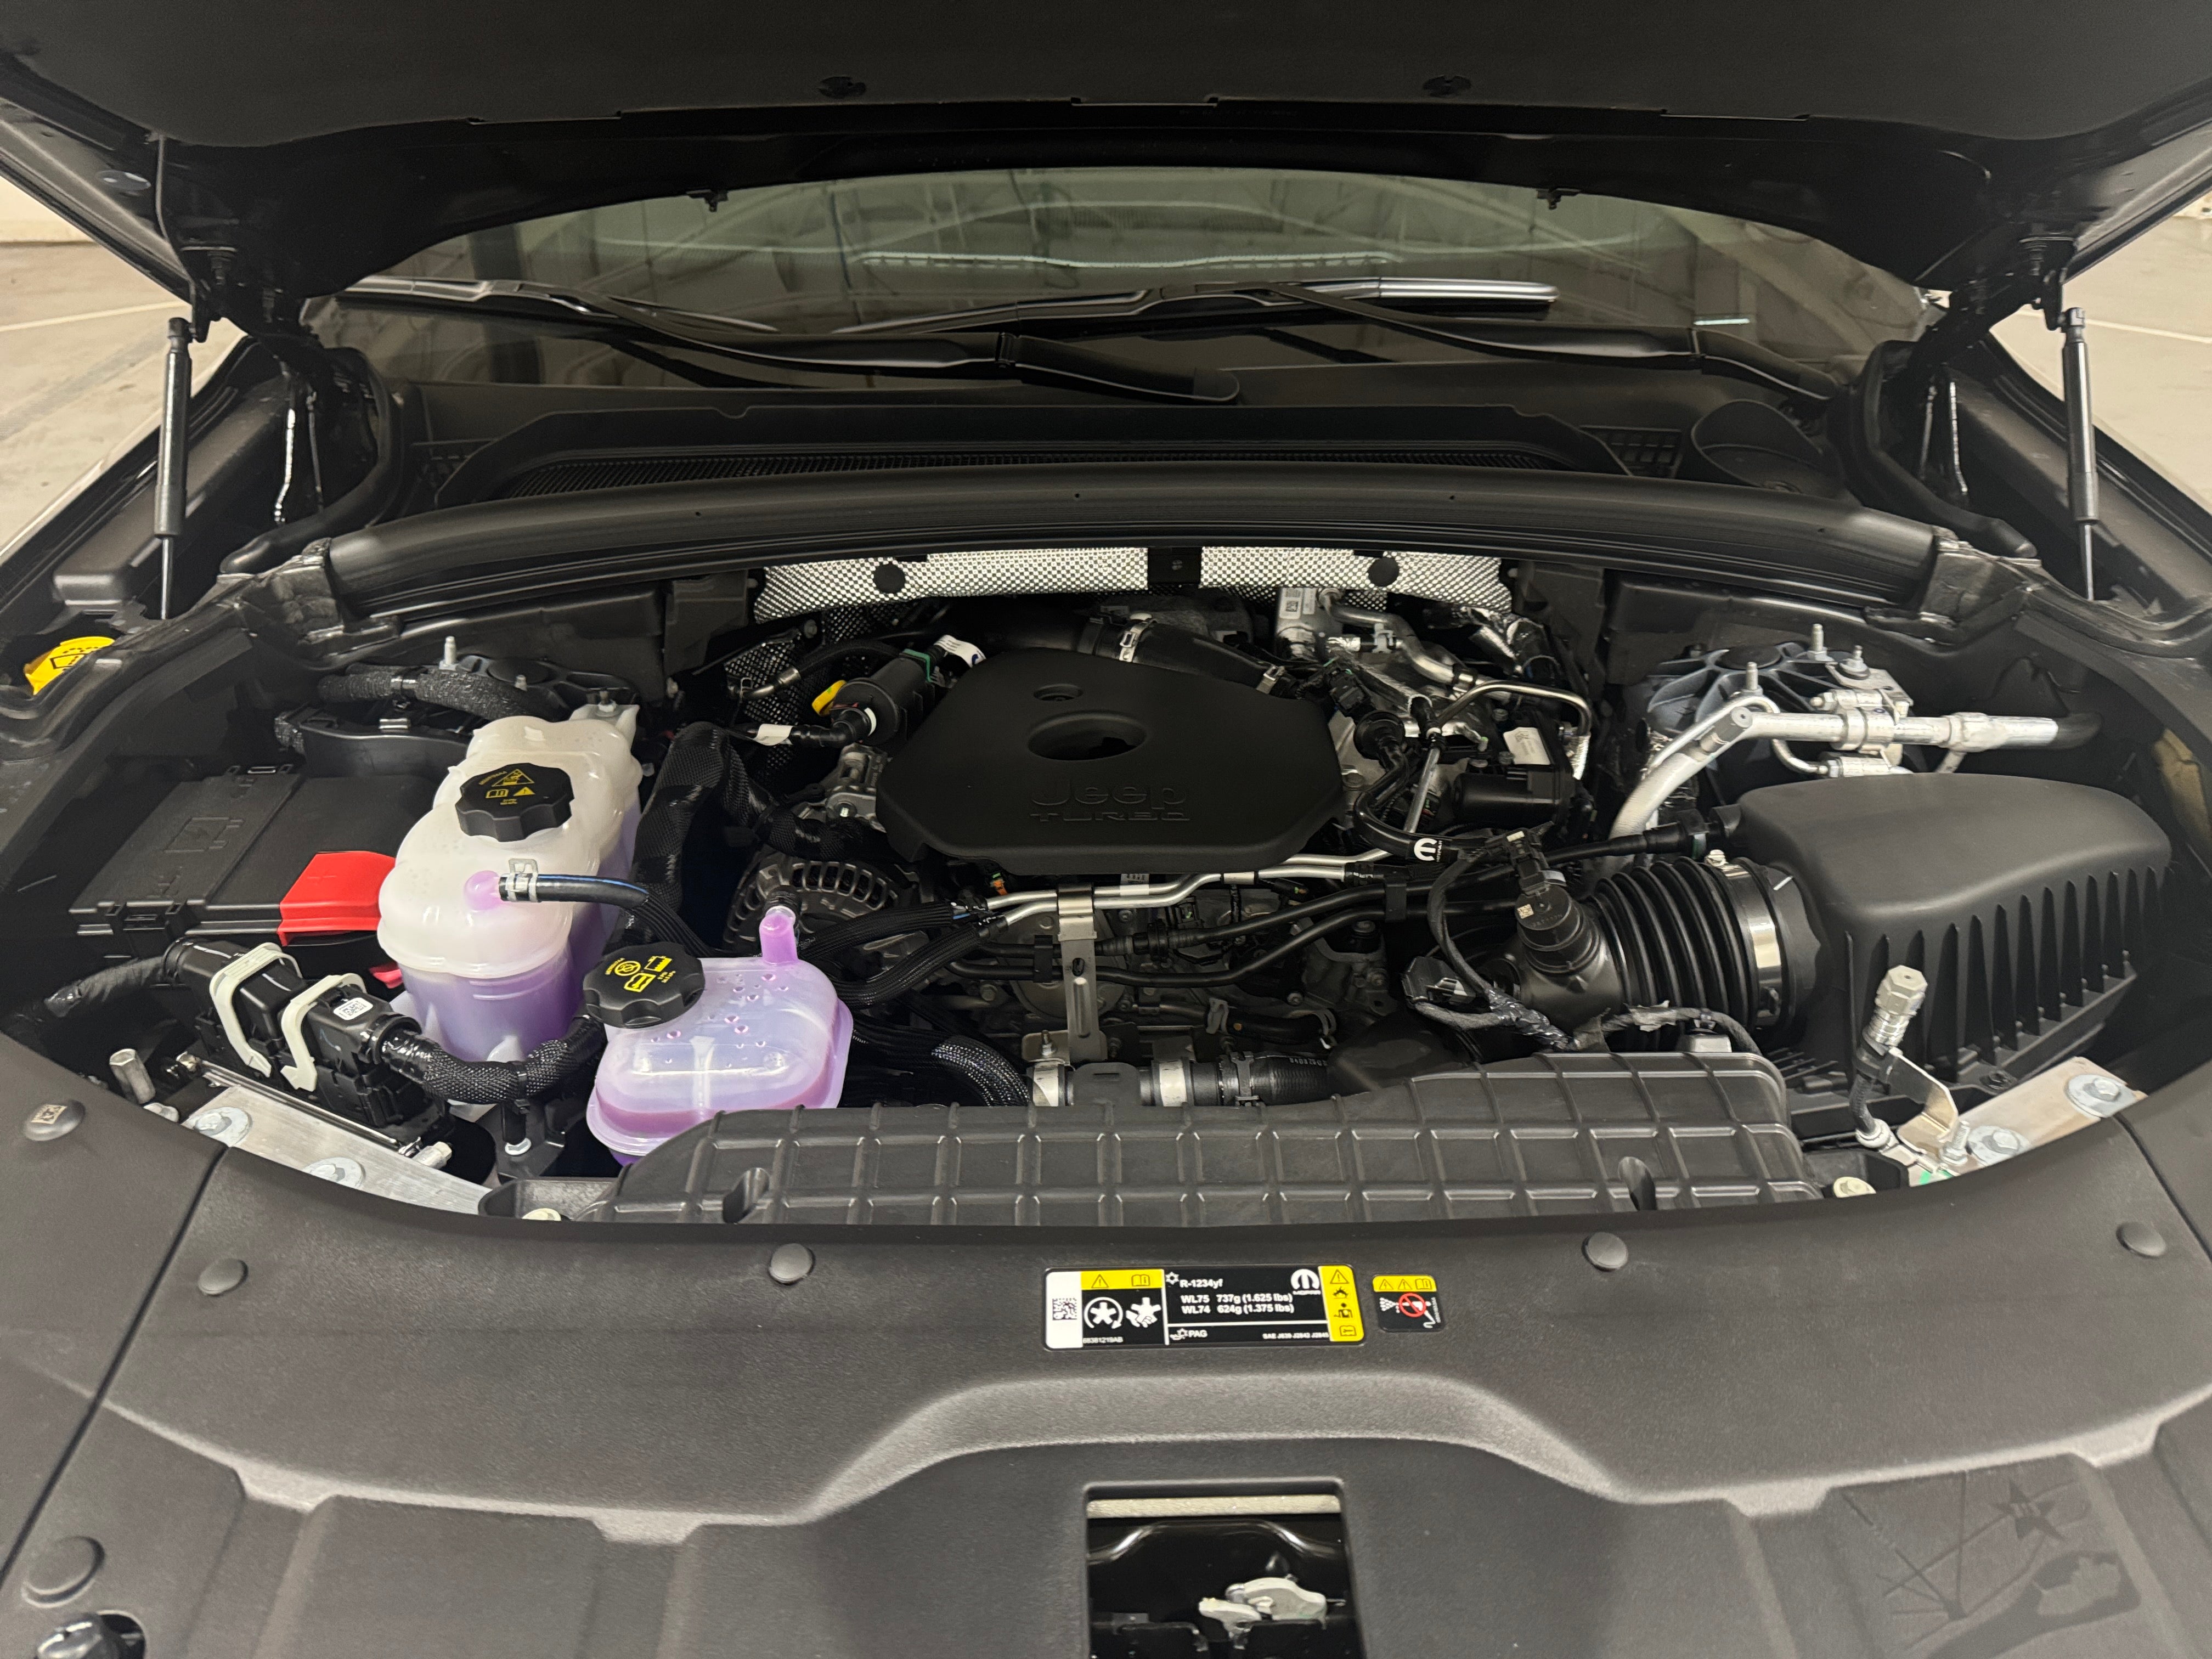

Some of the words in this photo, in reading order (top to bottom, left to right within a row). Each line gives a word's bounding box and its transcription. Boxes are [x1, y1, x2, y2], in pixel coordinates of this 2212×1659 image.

[1031, 780, 1187, 810] Jeep
[1029, 811, 1190, 822] TURBO
[1180, 1278, 1223, 1289] R-1234yf
[1181, 1295, 1210, 1304] WL75
[1216, 1294, 1241, 1304] 737g
[1242, 1293, 1272, 1304] (1.625
[1273, 1293, 1293, 1303] lbs)
[1181, 1305, 1211, 1314] WL74
[1217, 1305, 1242, 1315] 624g
[1243, 1304, 1274, 1314] (1.375
[1275, 1304, 1294, 1313] lbs)
[1188, 1329, 1207, 1338] PAG
